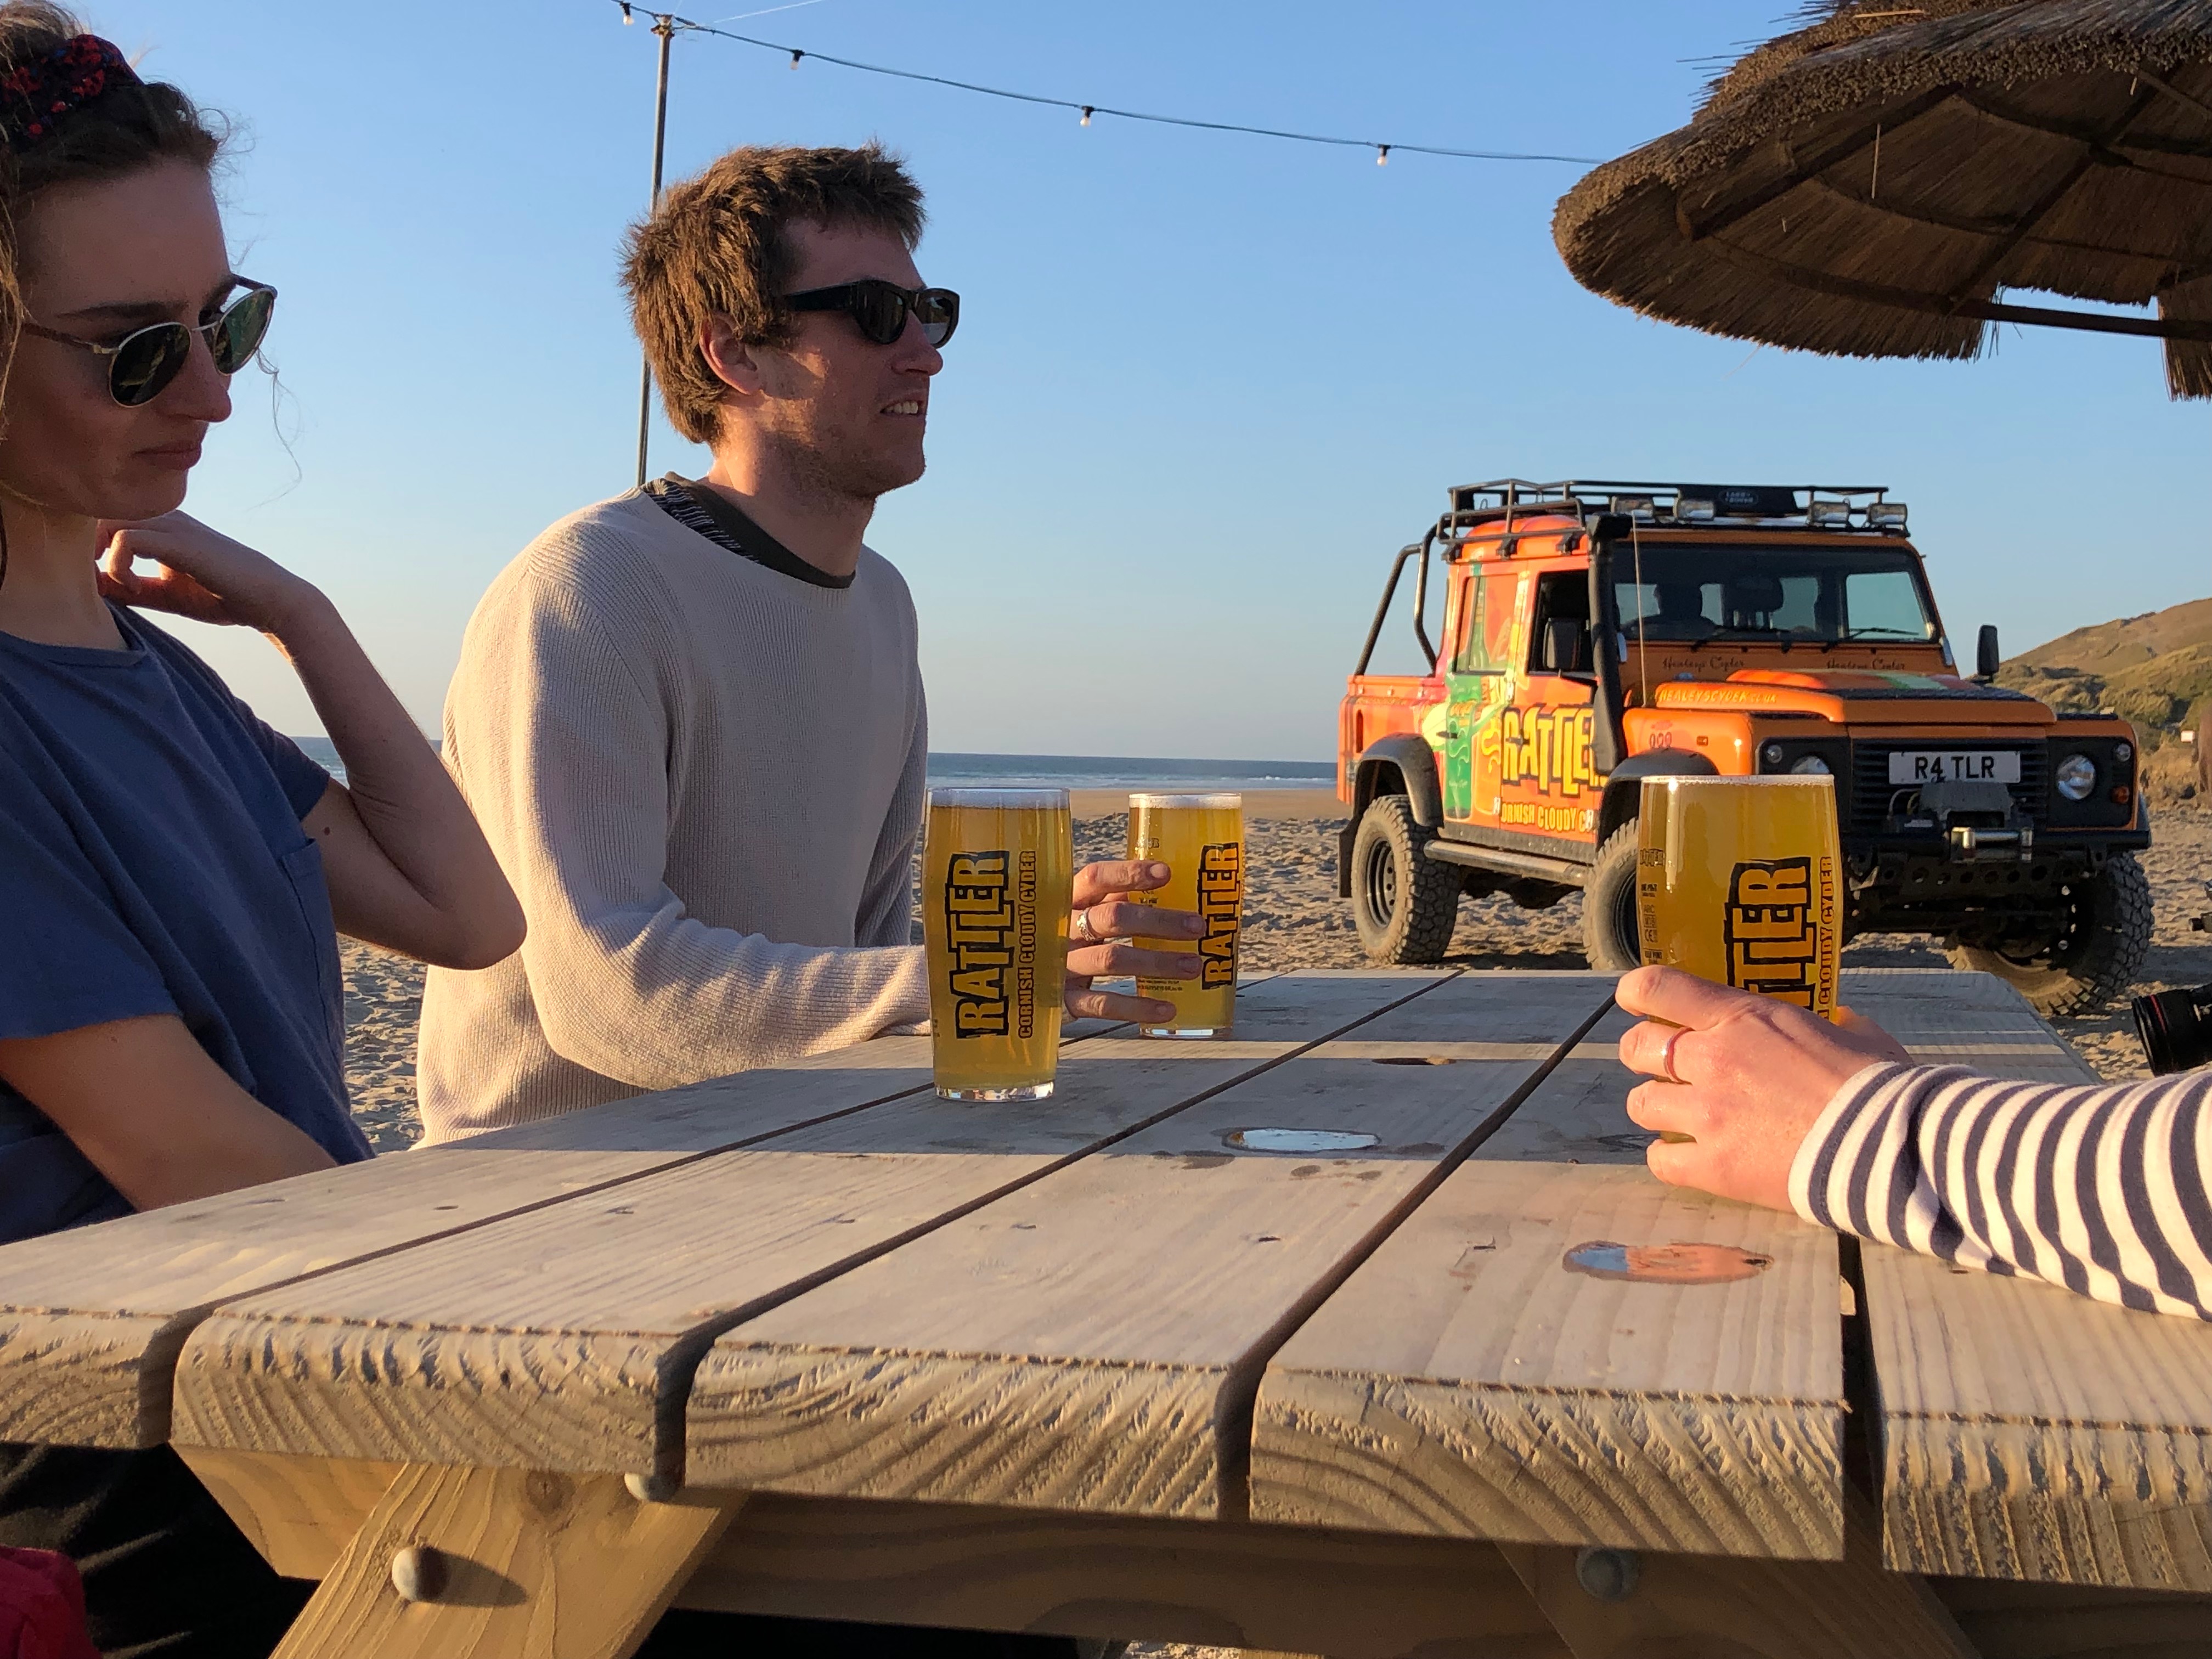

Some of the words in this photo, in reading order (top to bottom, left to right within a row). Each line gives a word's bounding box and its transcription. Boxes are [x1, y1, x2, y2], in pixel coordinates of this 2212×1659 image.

[1915, 756, 1943, 779] R4
[1951, 756, 1994, 778] TLR
[1500, 803, 1535, 825] ORNISH
[1538, 806, 1577, 831] CLOUDY
[1019, 850, 1036, 903] CYDER
[1820, 856, 1834, 924] CYDER
[945, 850, 1015, 1039] RATTLER
[1019, 901, 1036, 963] CLOUDY
[1197, 842, 1240, 990] RATTLER
[1724, 857, 1817, 1011] TTLER
[1818, 926, 1833, 1005] CLOUDY
[1018, 967, 1034, 1039] CORNISH
